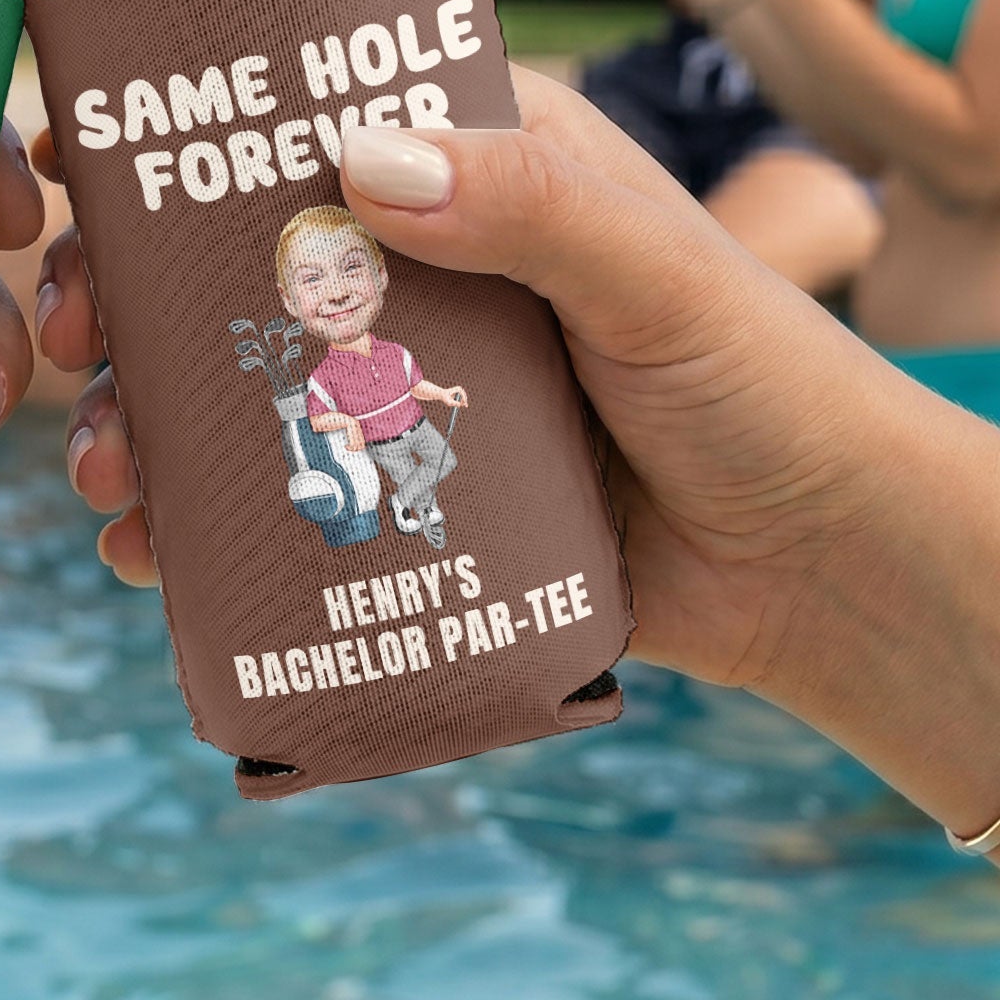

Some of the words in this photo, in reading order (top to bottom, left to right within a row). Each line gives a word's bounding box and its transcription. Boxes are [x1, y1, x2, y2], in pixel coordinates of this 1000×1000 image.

[74, 55, 277, 150] SAME
[233, 625, 432, 699] BACHELOR
[438, 572, 593, 663] PAR-TEE
[322, 554, 482, 631] HENRY'S
